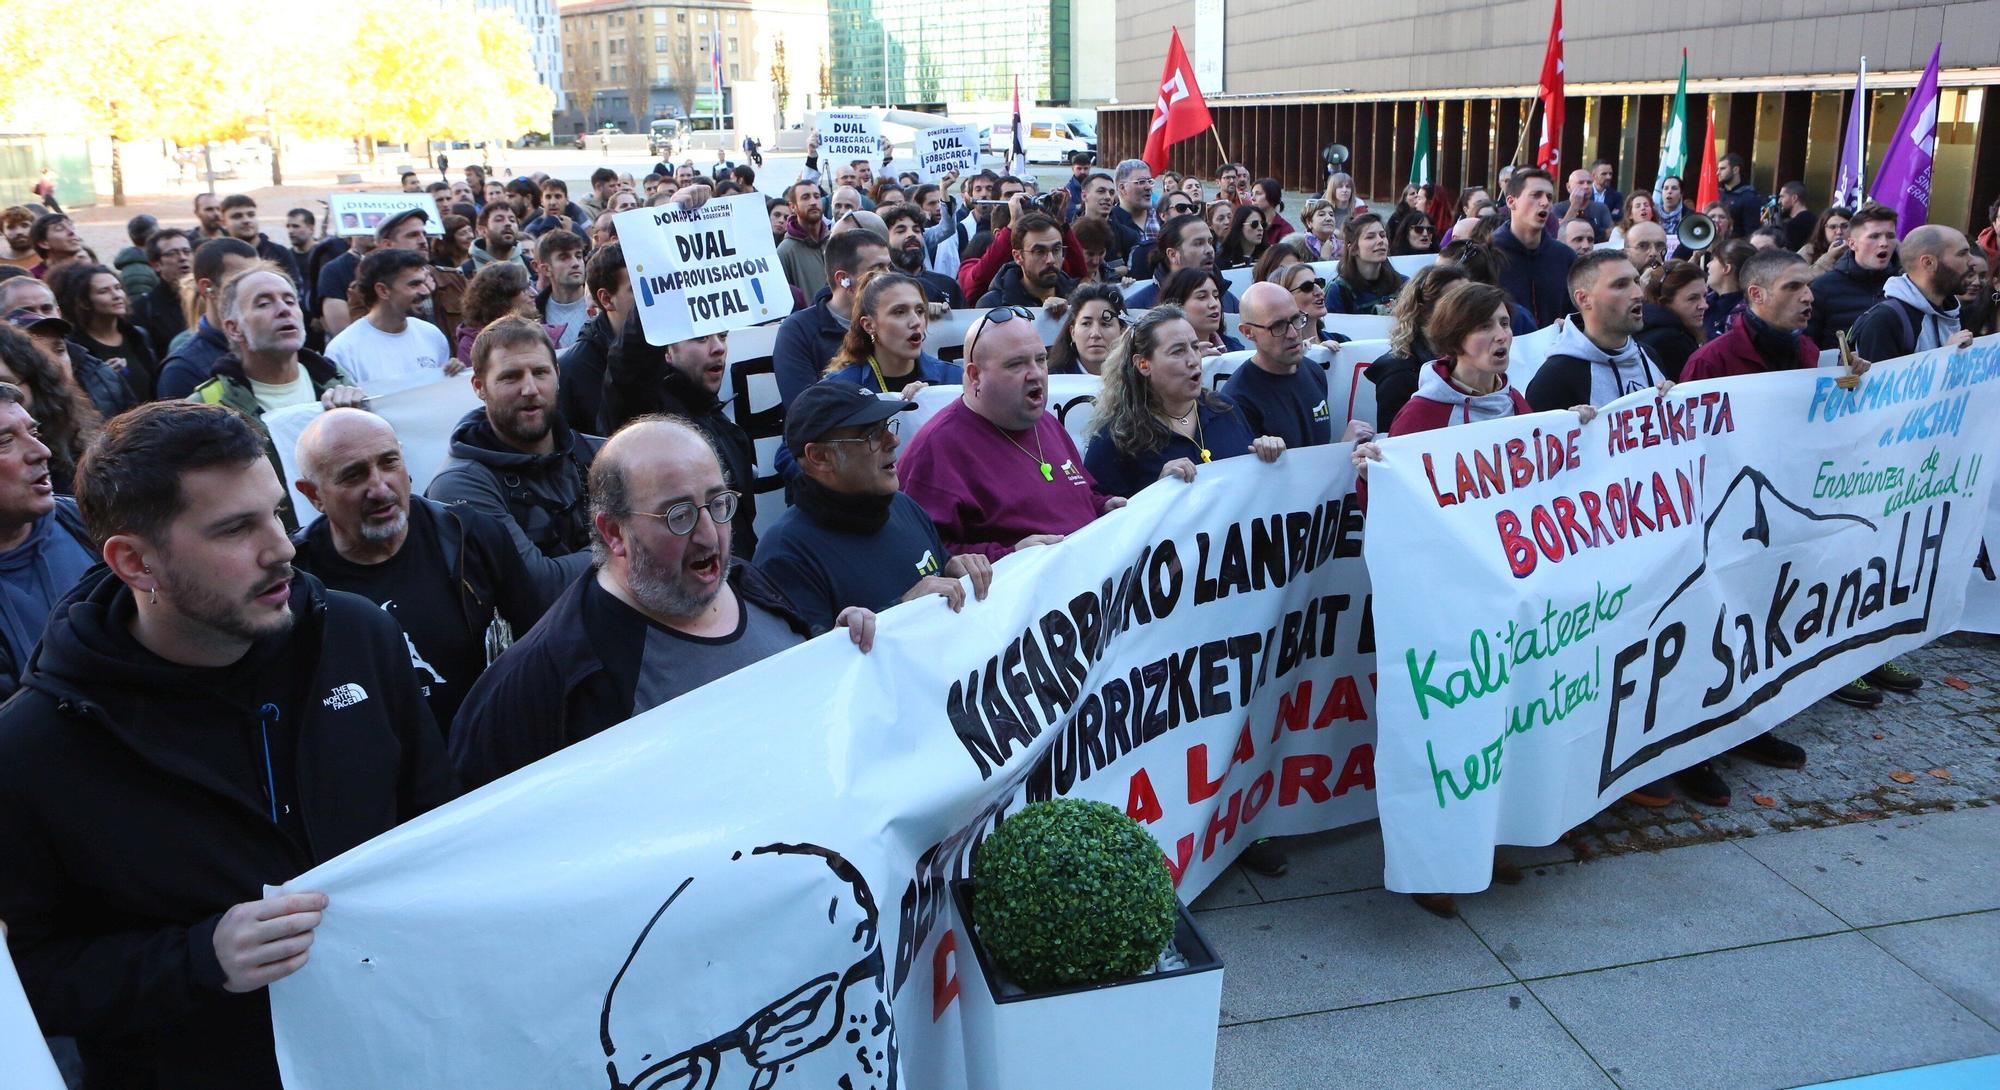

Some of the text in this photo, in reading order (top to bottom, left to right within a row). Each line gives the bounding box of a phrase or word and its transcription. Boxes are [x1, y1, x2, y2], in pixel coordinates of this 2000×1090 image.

[833, 123, 866, 133] DUAL
[932, 137, 962, 151] DUAL
[653, 207, 702, 226] DONAPEA
[675, 230, 737, 263] DUAL
[1808, 353, 1937, 423] FORMACIÓN
[1920, 445, 1940, 474] de
[1194, 493, 1365, 606] LANBIDE
[1275, 594, 1351, 679] BAT
[331, 684, 349, 696] THE
[1604, 620, 1688, 737] FP
[323, 691, 351, 707] NORTH
[332, 699, 355, 711] FACE
[1426, 645, 1600, 809] hezuntza!
[1187, 714, 1255, 805] LA
